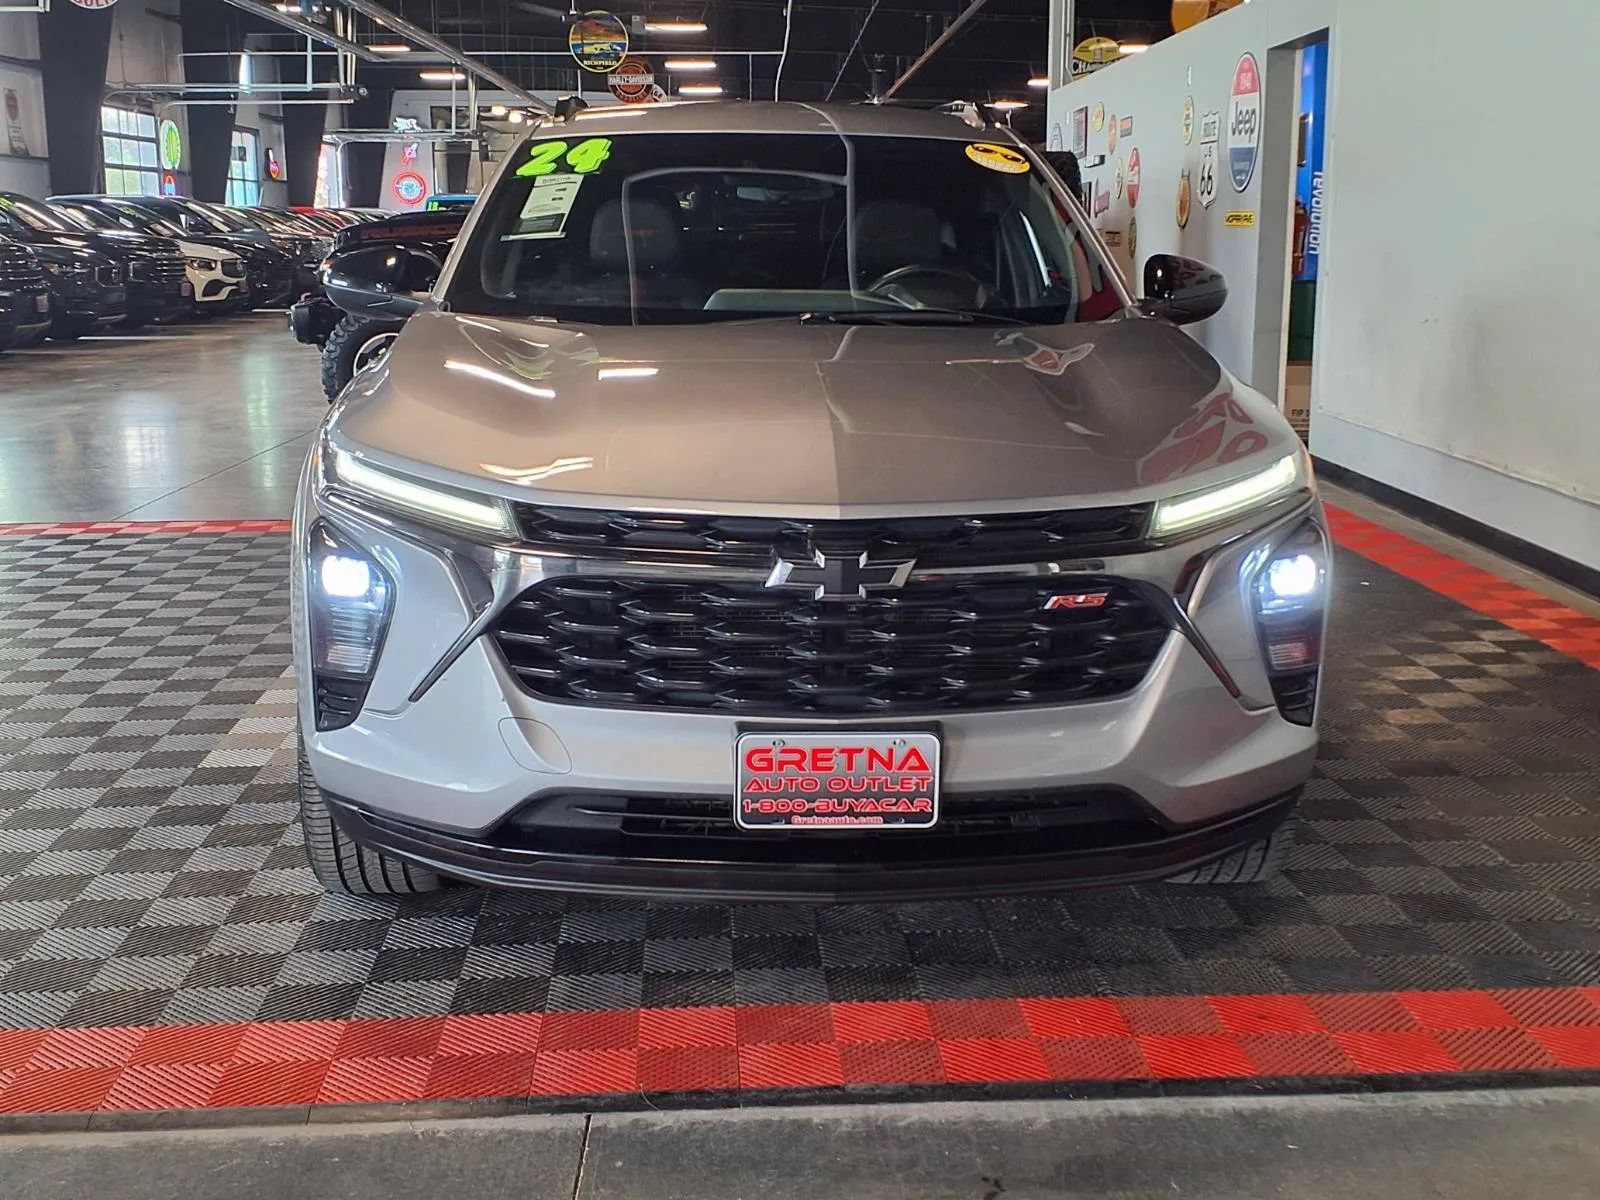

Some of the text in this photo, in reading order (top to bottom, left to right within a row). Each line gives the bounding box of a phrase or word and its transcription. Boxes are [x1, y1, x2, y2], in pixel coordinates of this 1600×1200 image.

[1232, 101, 1257, 142] Jeep
[516, 138, 612, 176] 24
[1200, 163, 1213, 195] 66
[1043, 592, 1108, 609] RS
[744, 747, 932, 774] GRETNA
[743, 776, 934, 793] AUTO OUTLET
[743, 798, 932, 813] 1-800-BUYACAR
